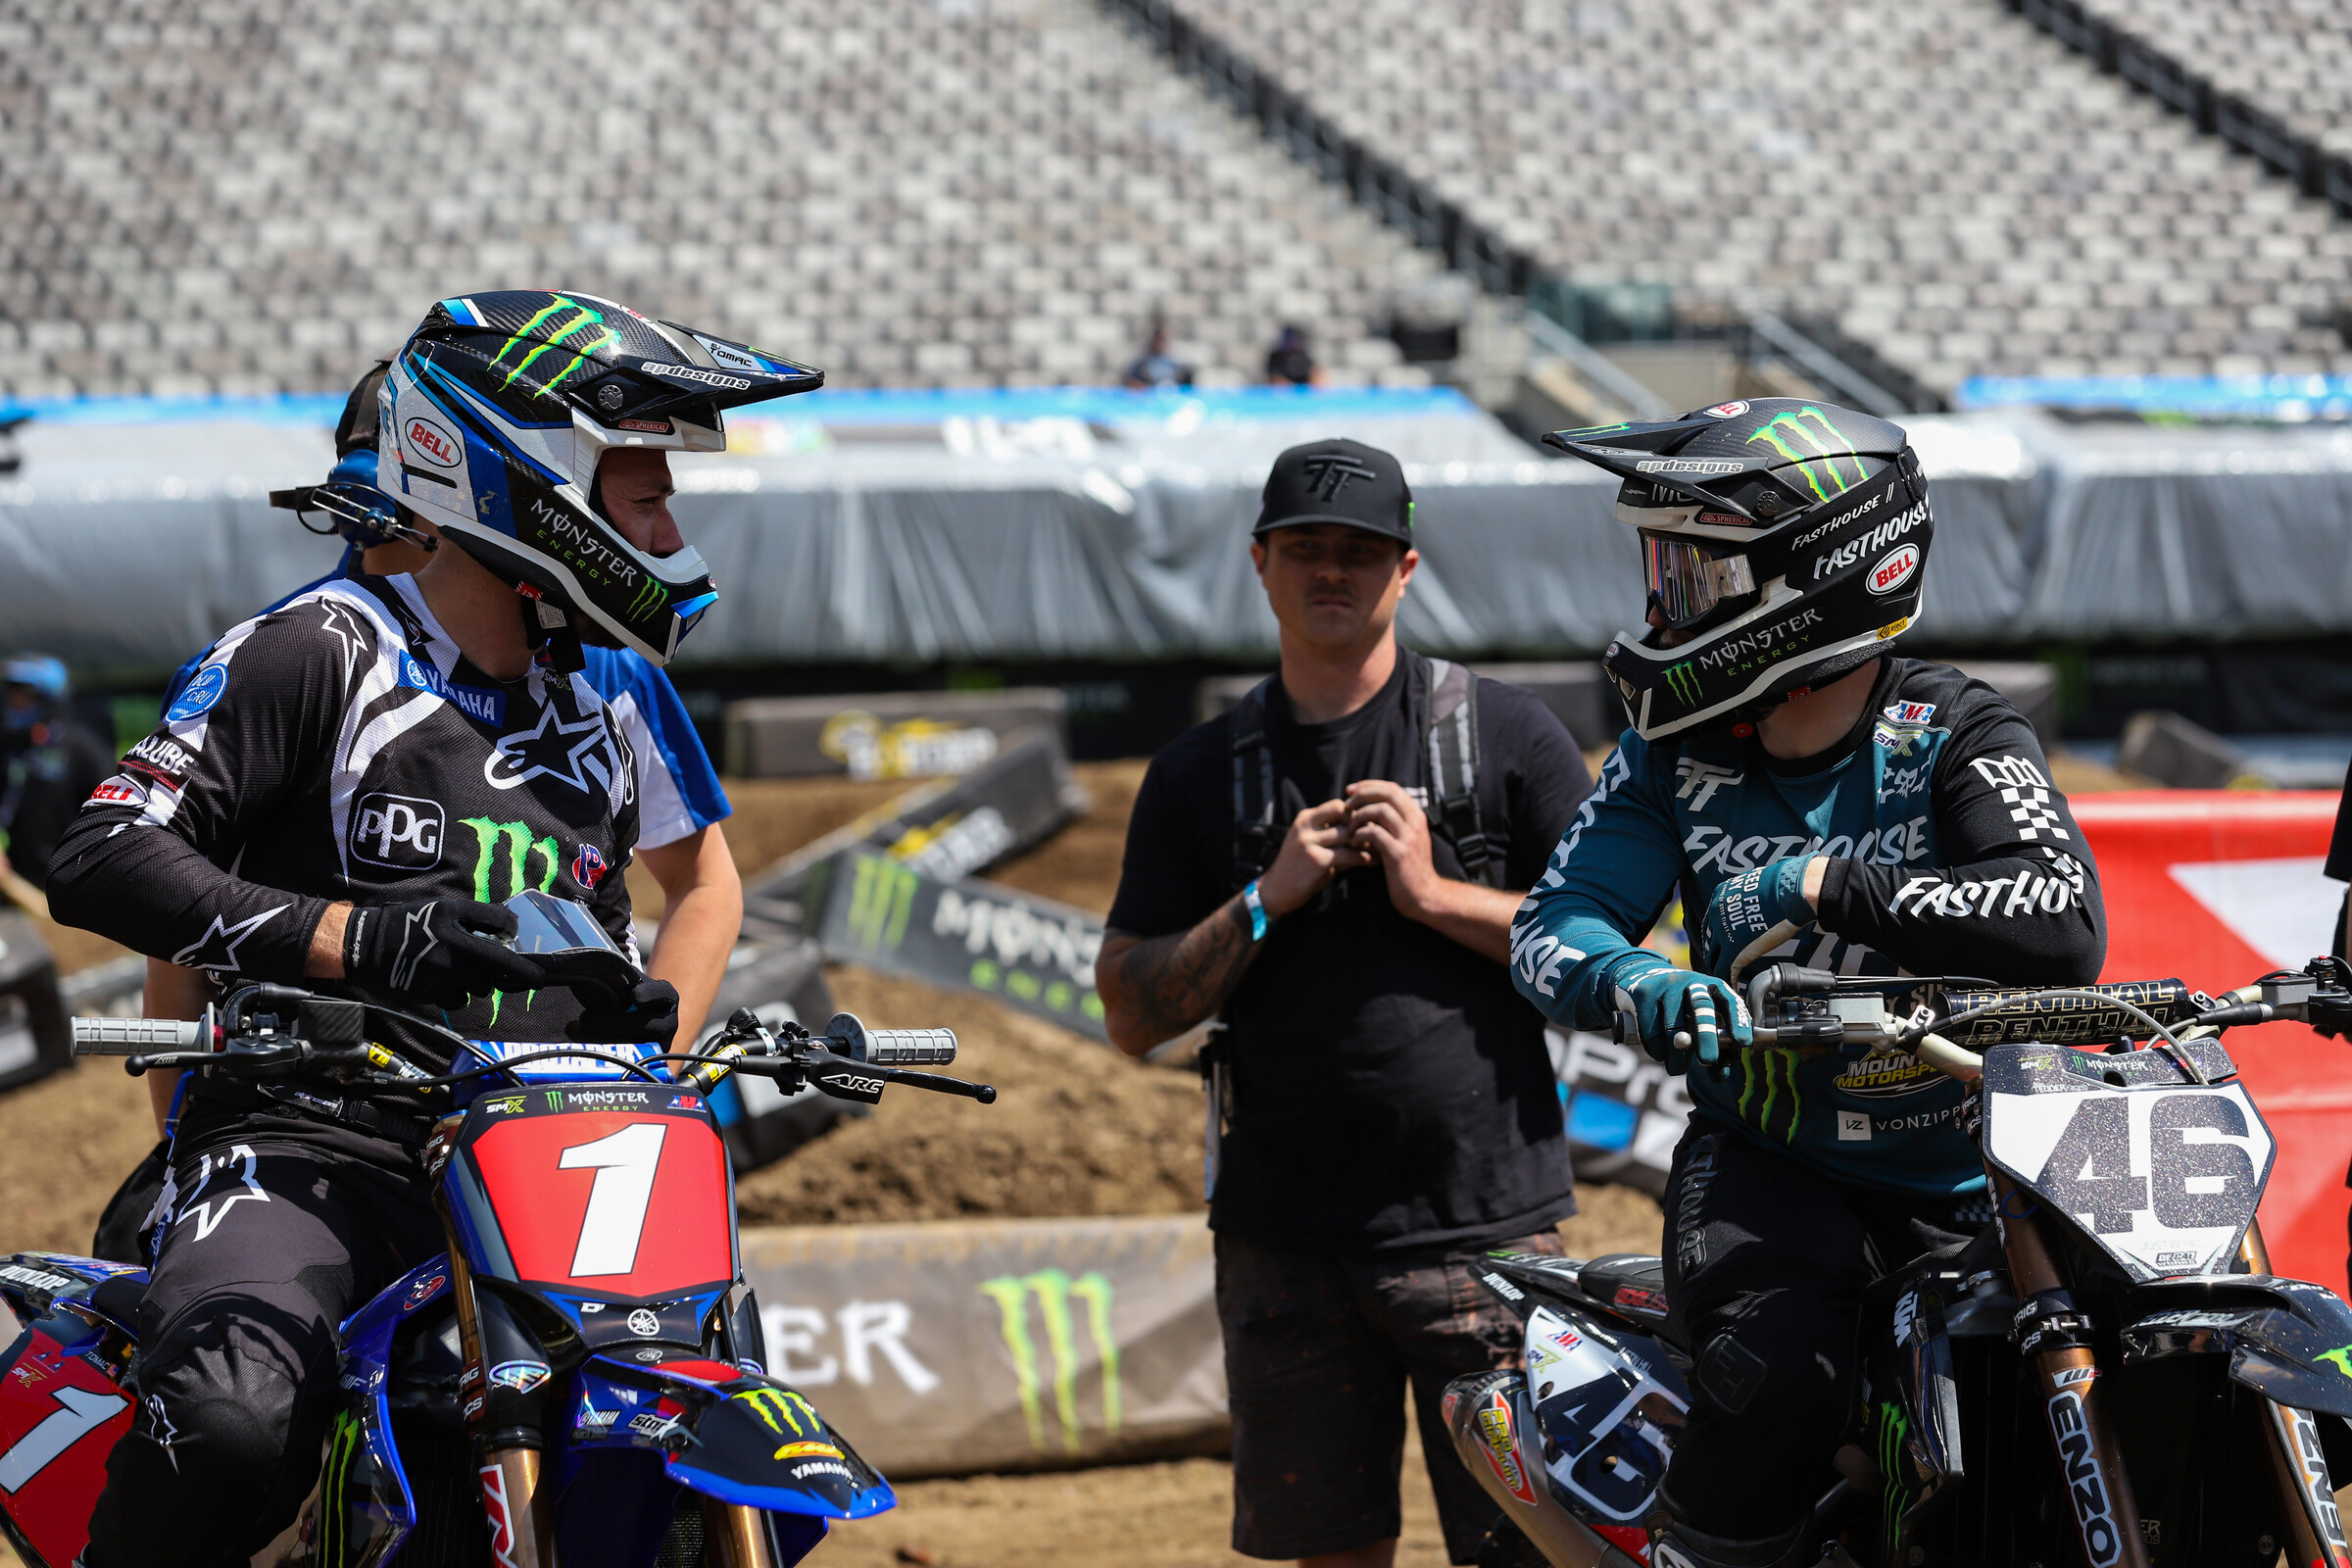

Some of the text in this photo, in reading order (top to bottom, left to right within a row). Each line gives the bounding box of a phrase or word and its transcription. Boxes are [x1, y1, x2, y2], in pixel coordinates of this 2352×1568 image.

[641, 361, 752, 390] apdesigns
[710, 346, 753, 368] TOMAC
[411, 422, 452, 464] BELL
[1636, 459, 1744, 473] apdesigns
[530, 498, 638, 587] MONSTER
[1791, 494, 1882, 551] FASTHOUSE
[536, 529, 612, 586] ENERGY
[1876, 553, 1914, 589] BELL
[1699, 608, 1824, 670] MONSTER
[1728, 634, 1810, 676] ENERGY
[357, 803, 439, 858] PPG
[1726, 893, 1745, 931] SOUL
[567, 1090, 650, 1104] MONSTER
[820, 1073, 885, 1094] ARC
[485, 1095, 527, 1114] SMX
[2035, 1094, 2256, 1235] 46
[557, 1122, 668, 1278] 1
[1482, 1272, 1526, 1301] DUNLOP
[84, 1350, 111, 1371] TOMAC
[0, 1385, 132, 1495] 1
[791, 1462, 854, 1480] YAMAHA
[2050, 1394, 2119, 1566] ENZO
